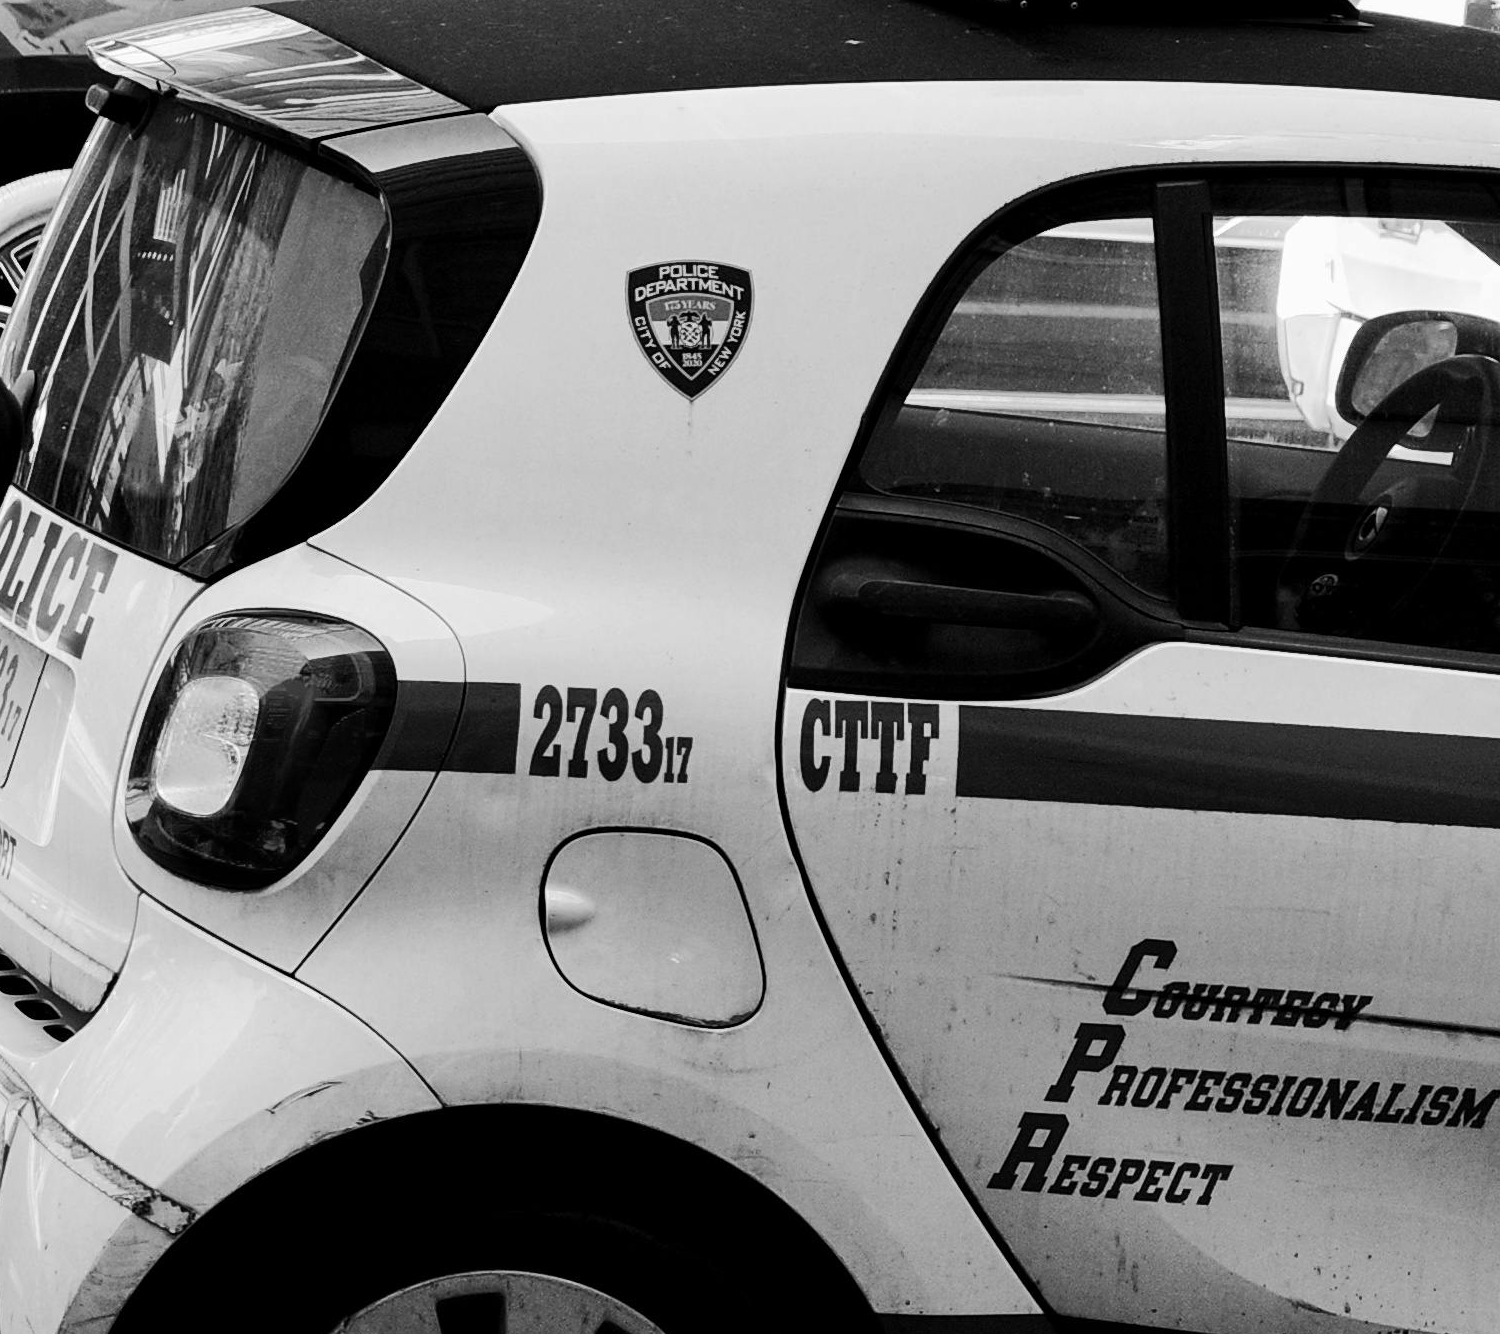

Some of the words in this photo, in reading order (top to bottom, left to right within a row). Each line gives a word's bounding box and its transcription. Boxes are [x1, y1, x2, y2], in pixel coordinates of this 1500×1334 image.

[634, 277, 745, 302] DEPARTMENT
[659, 264, 719, 280] POLICE
[681, 299, 717, 311] YEARS
[634, 316, 657, 349] CITY
[651, 351, 671, 370] OF
[707, 346, 733, 376] NEW
[727, 310, 747, 344] YORK
[799, 697, 941, 796] CTTF
[1043, 1022, 1500, 1129] PROFESSIONALISM
[986, 1111, 1235, 1206] RESPECT
